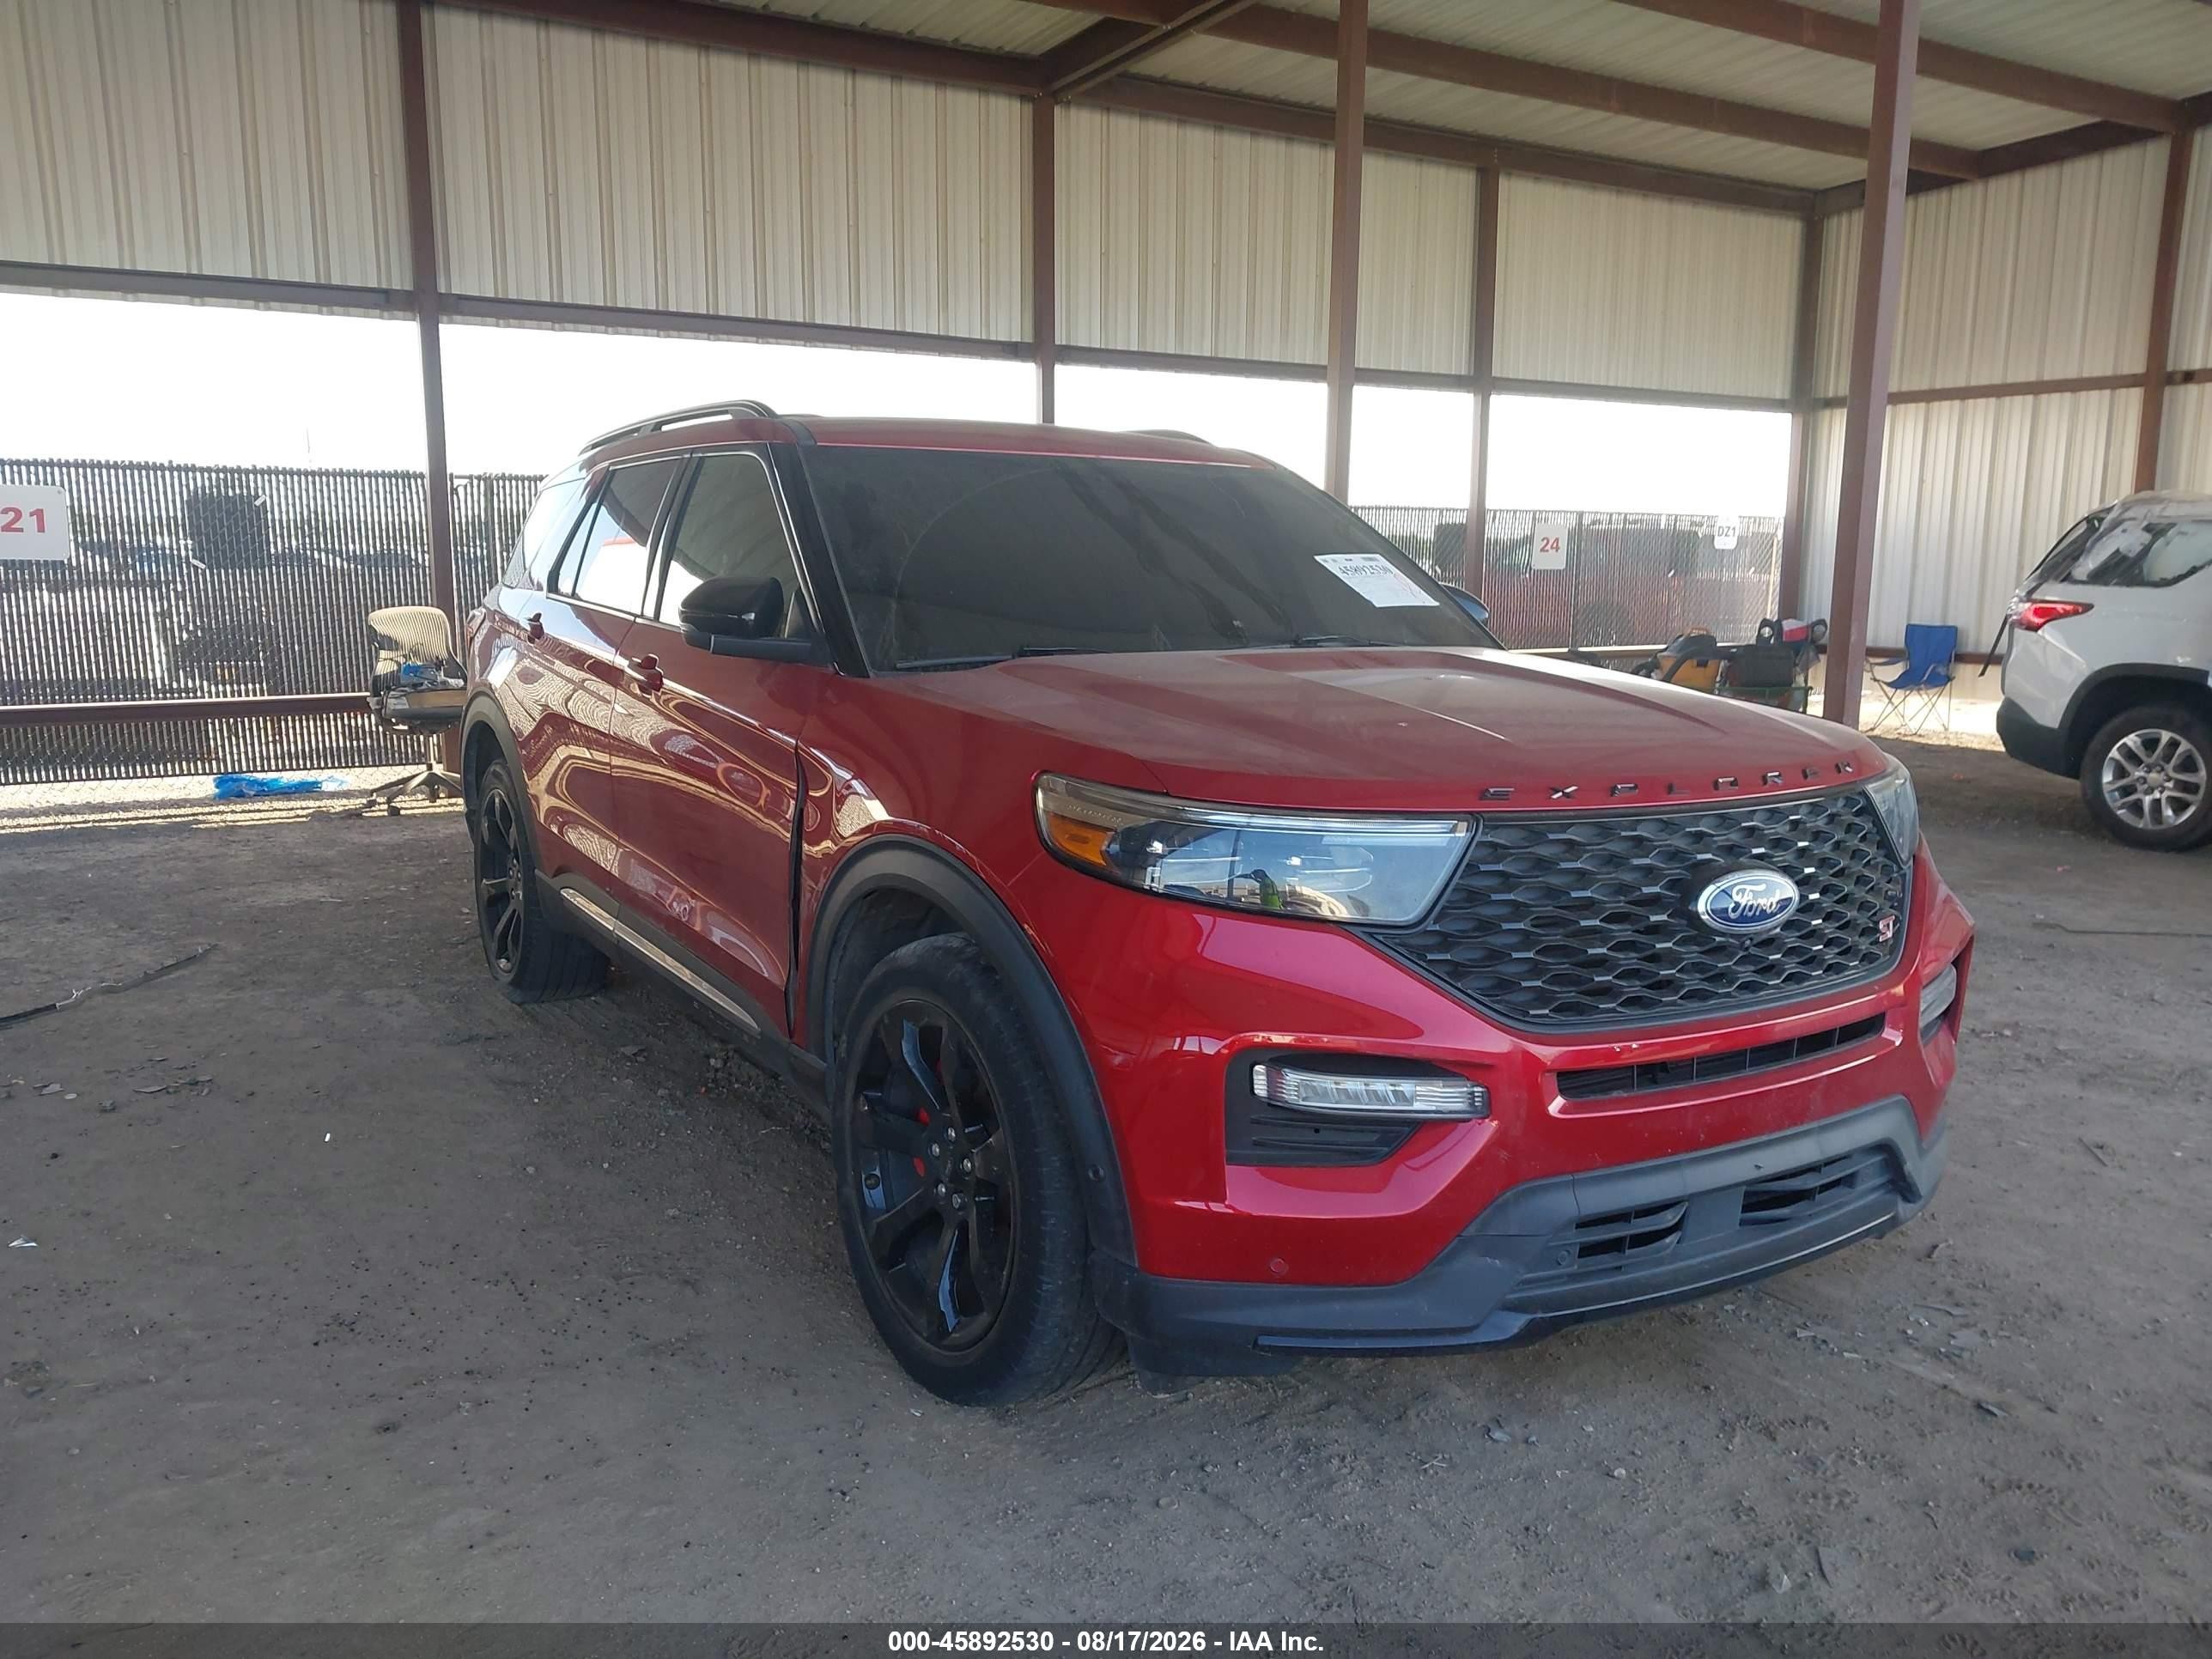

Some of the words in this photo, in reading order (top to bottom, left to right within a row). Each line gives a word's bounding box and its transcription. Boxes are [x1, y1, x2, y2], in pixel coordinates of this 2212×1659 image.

[0, 507, 46, 533] 21
[1717, 526, 1736, 538] DZ1
[1539, 537, 1561, 553] 24
[1479, 760, 1854, 800] EXPLORER
[1728, 883, 1781, 919] Ford
[1879, 915, 1895, 942] ST
